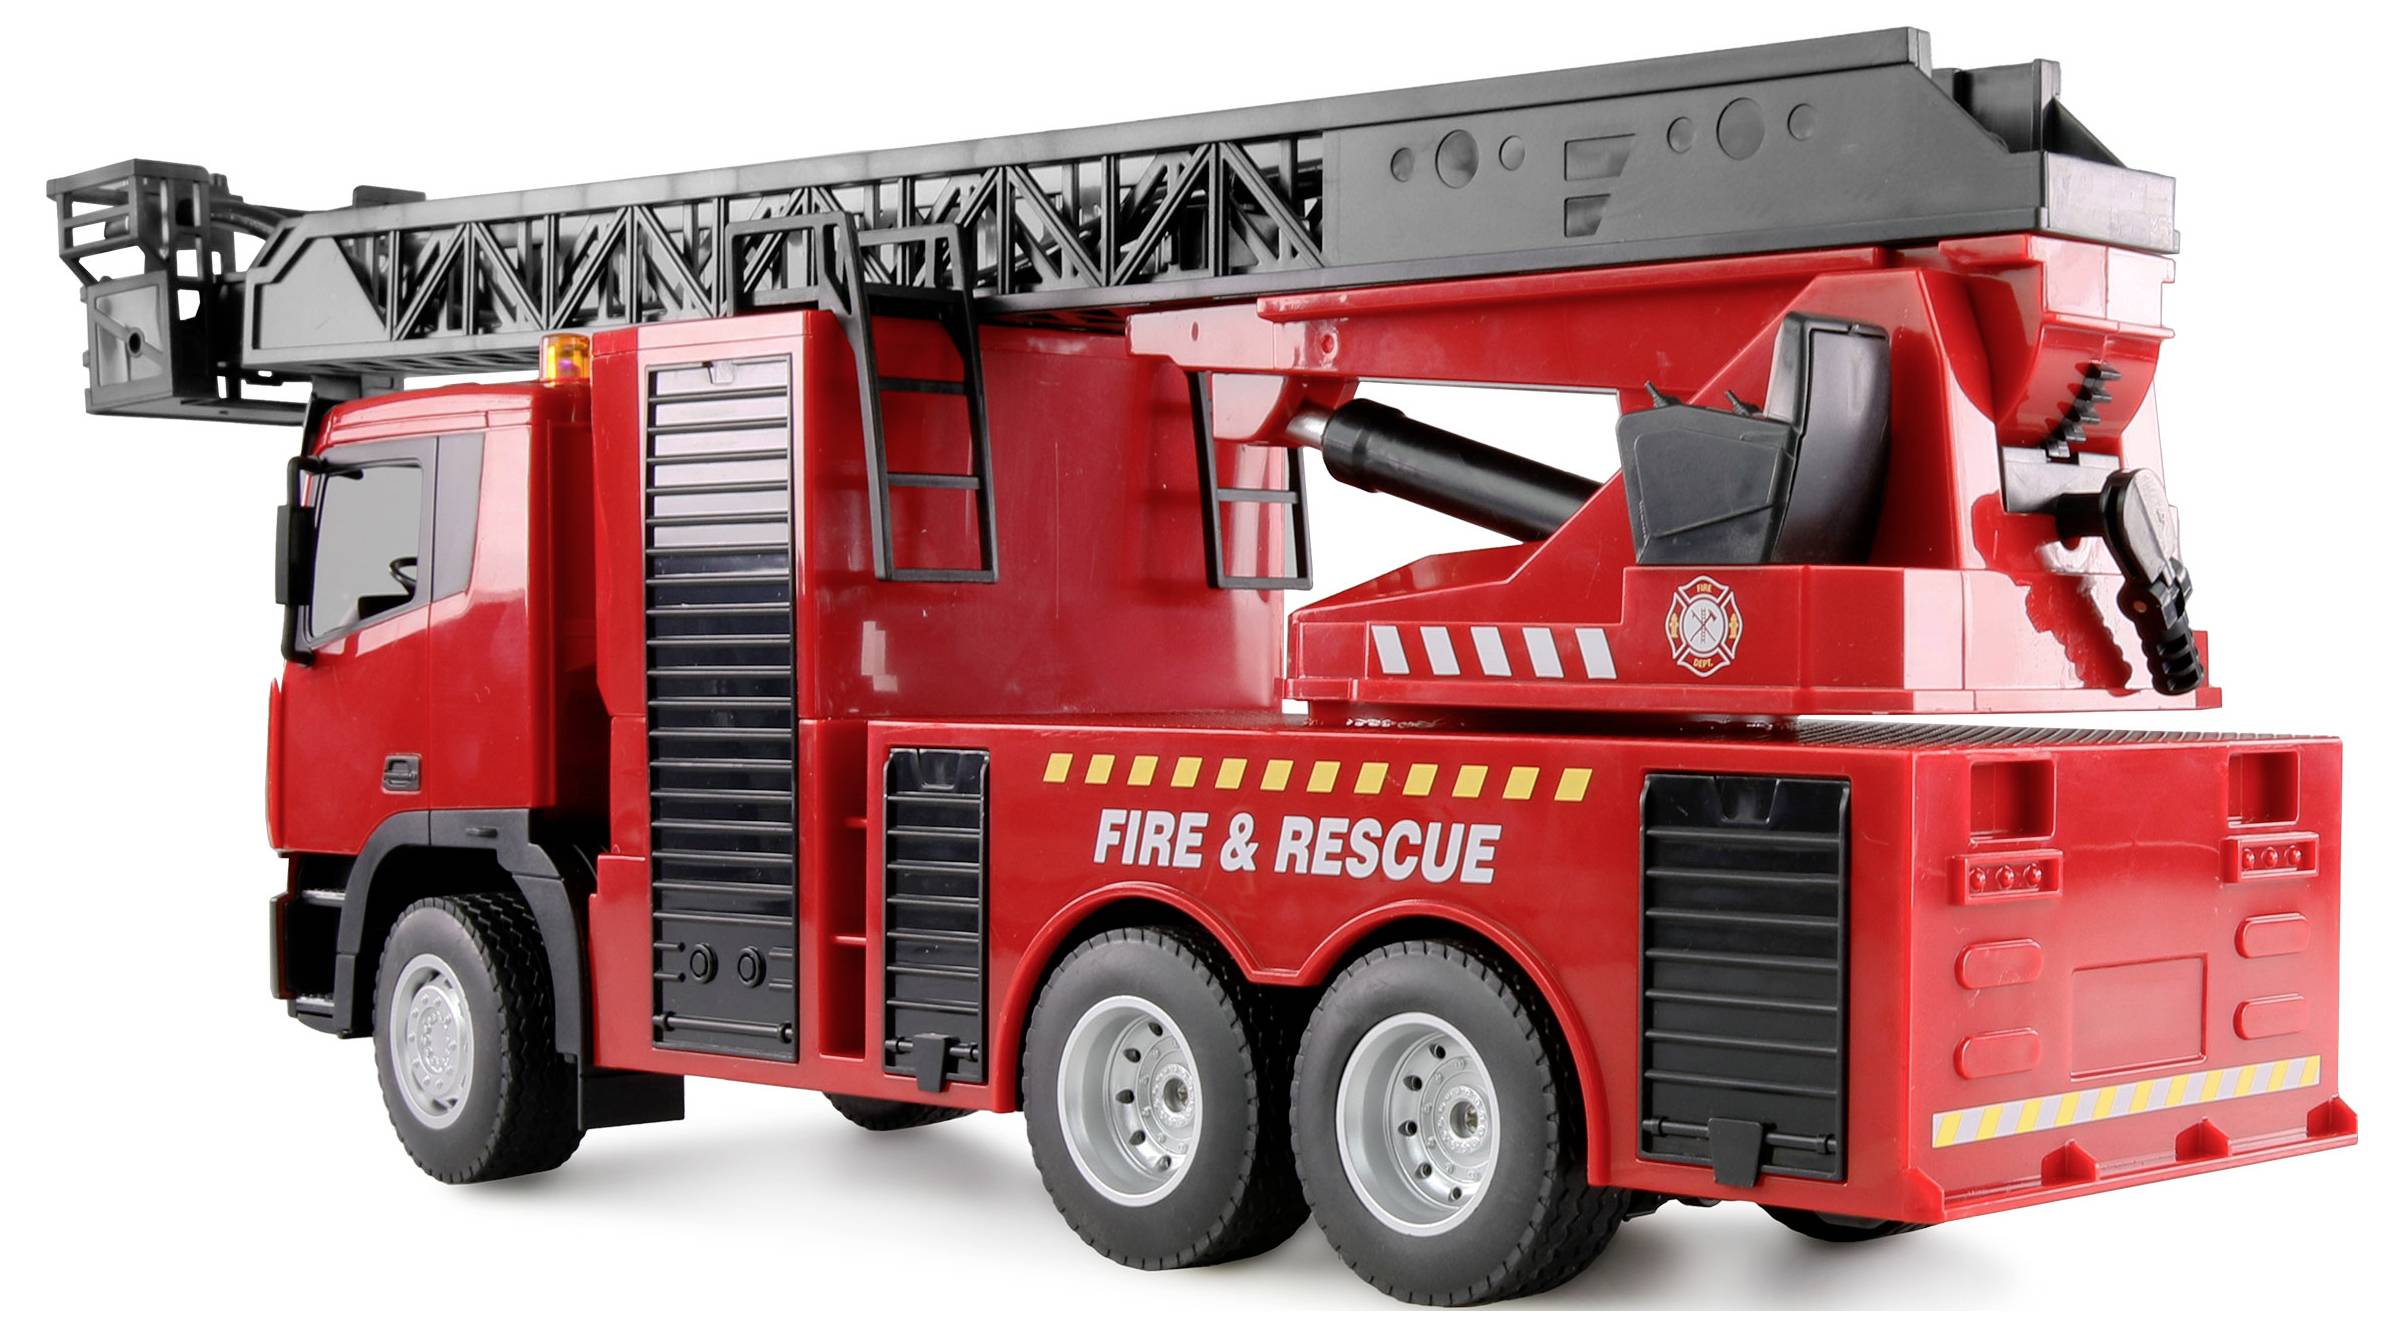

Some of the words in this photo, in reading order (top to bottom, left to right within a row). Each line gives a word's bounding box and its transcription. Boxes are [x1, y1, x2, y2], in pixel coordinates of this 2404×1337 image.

[1697, 583, 1712, 592] FIRE
[1093, 809, 1209, 868] FIRE
[1220, 812, 1259, 872] &
[1274, 816, 1502, 884] RESCUE
